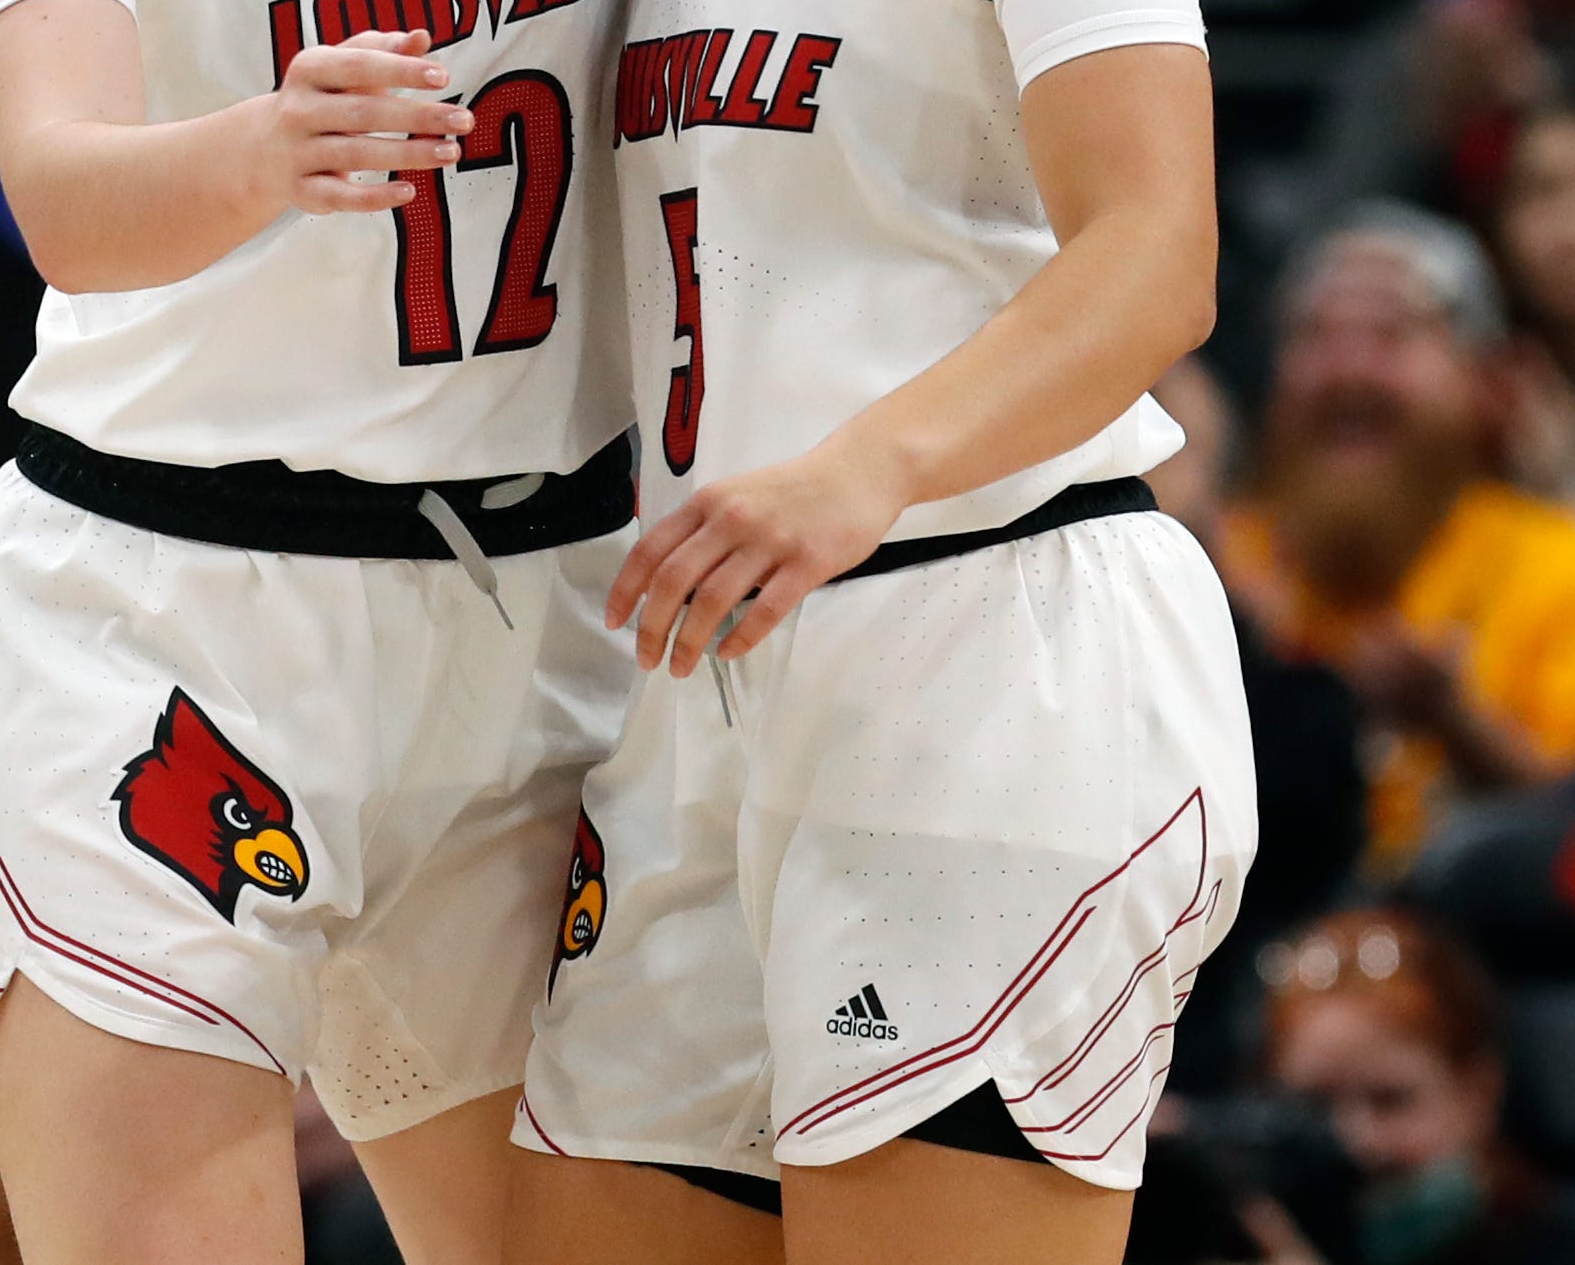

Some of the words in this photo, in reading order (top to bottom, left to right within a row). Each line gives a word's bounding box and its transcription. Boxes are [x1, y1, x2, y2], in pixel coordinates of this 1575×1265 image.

[388, 68, 575, 367] 12
[659, 187, 706, 477] 5
[826, 1016, 899, 1041] adidas
